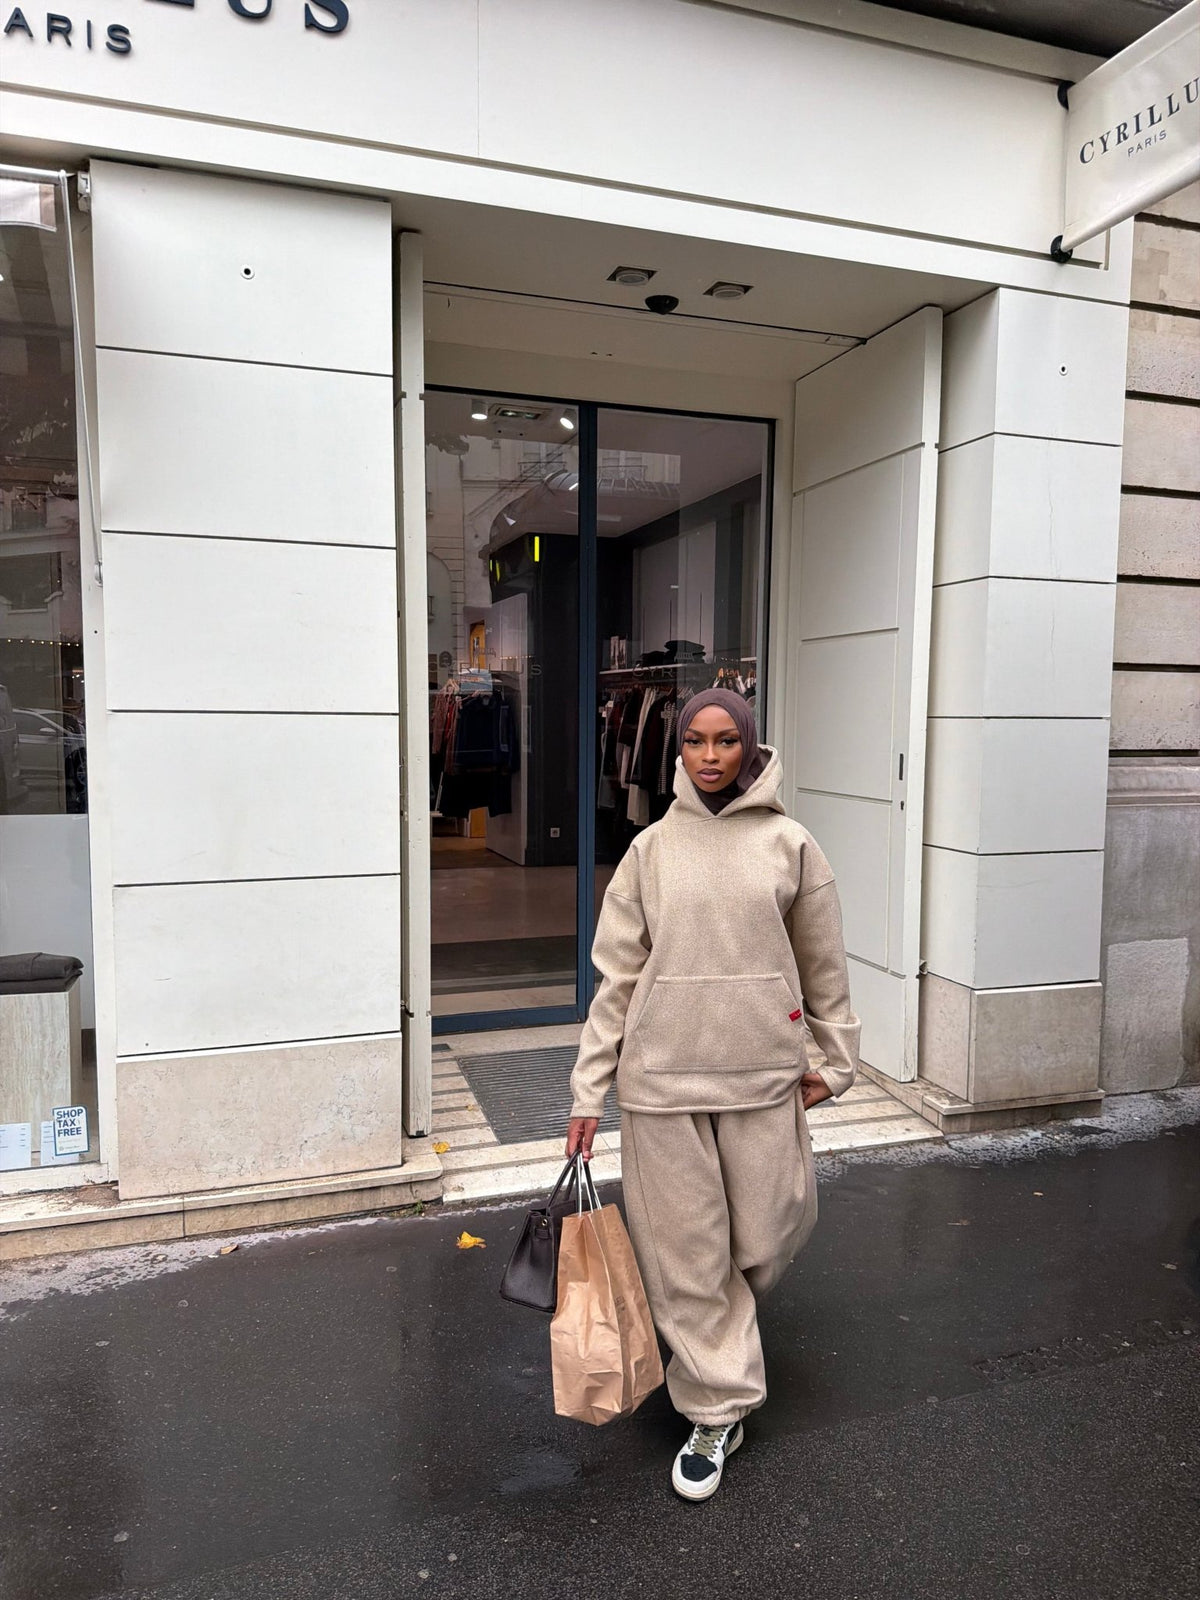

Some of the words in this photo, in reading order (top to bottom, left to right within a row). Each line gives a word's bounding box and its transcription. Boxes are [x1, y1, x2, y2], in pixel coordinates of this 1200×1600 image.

[1127, 129, 1167, 157] PARIS
[56, 1108, 83, 1119] SHOP
[57, 1118, 76, 1128] TAX
[57, 1127, 82, 1137] FREE
